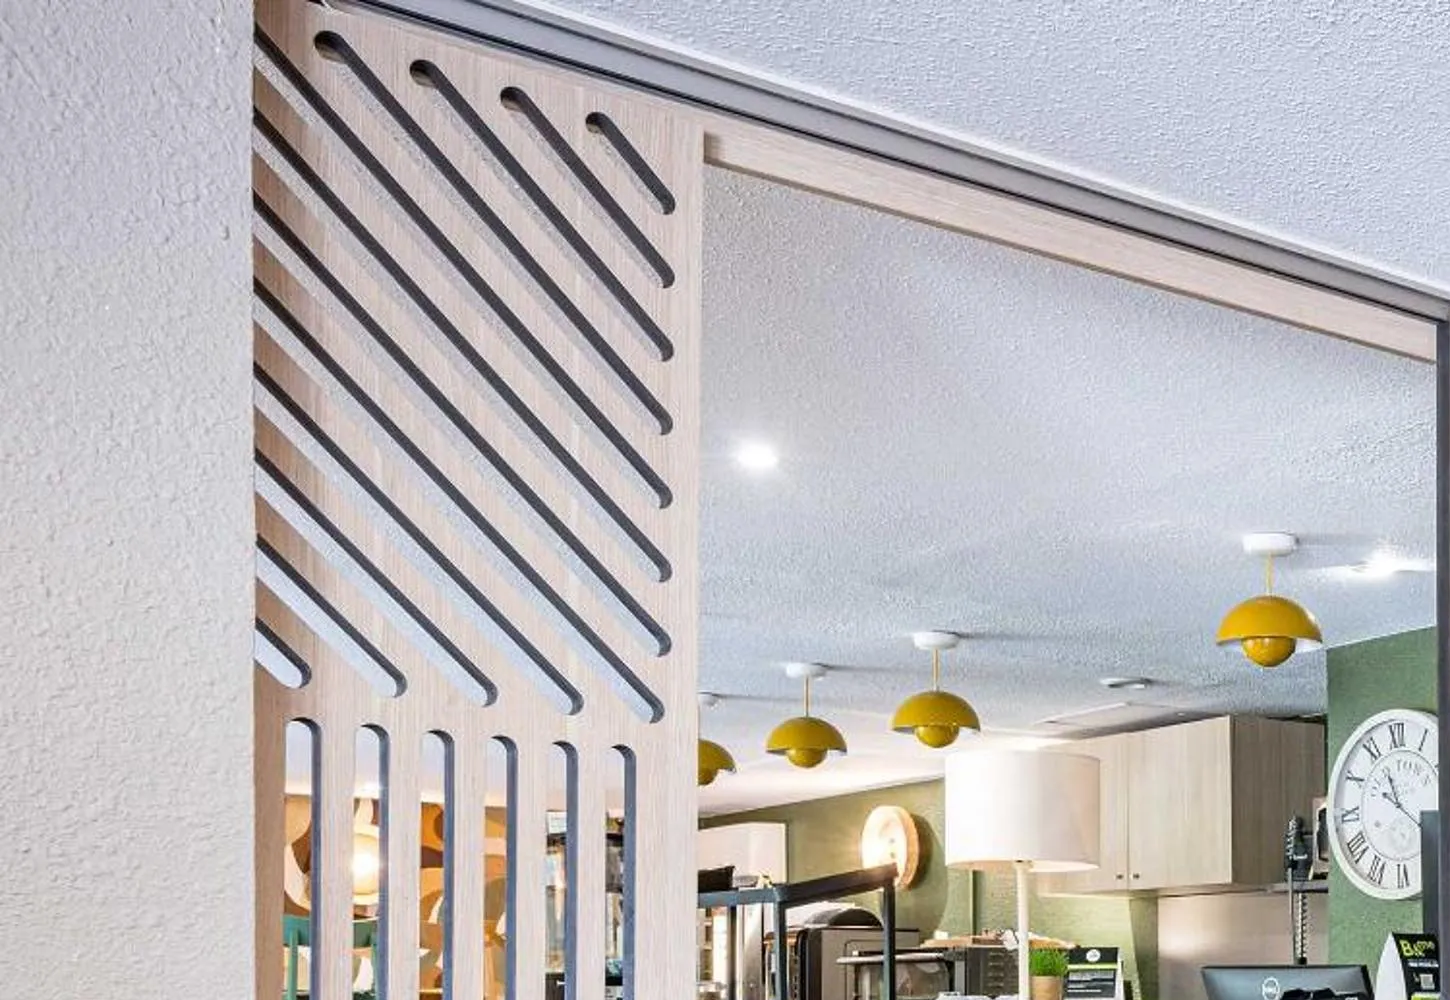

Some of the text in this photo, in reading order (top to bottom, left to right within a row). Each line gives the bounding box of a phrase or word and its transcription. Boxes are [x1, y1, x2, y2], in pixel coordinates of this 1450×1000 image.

[1388, 722, 1406, 750] XII
[1363, 737, 1381, 761] XI
[1346, 770, 1365, 788] X
[1341, 806, 1360, 823] IX
